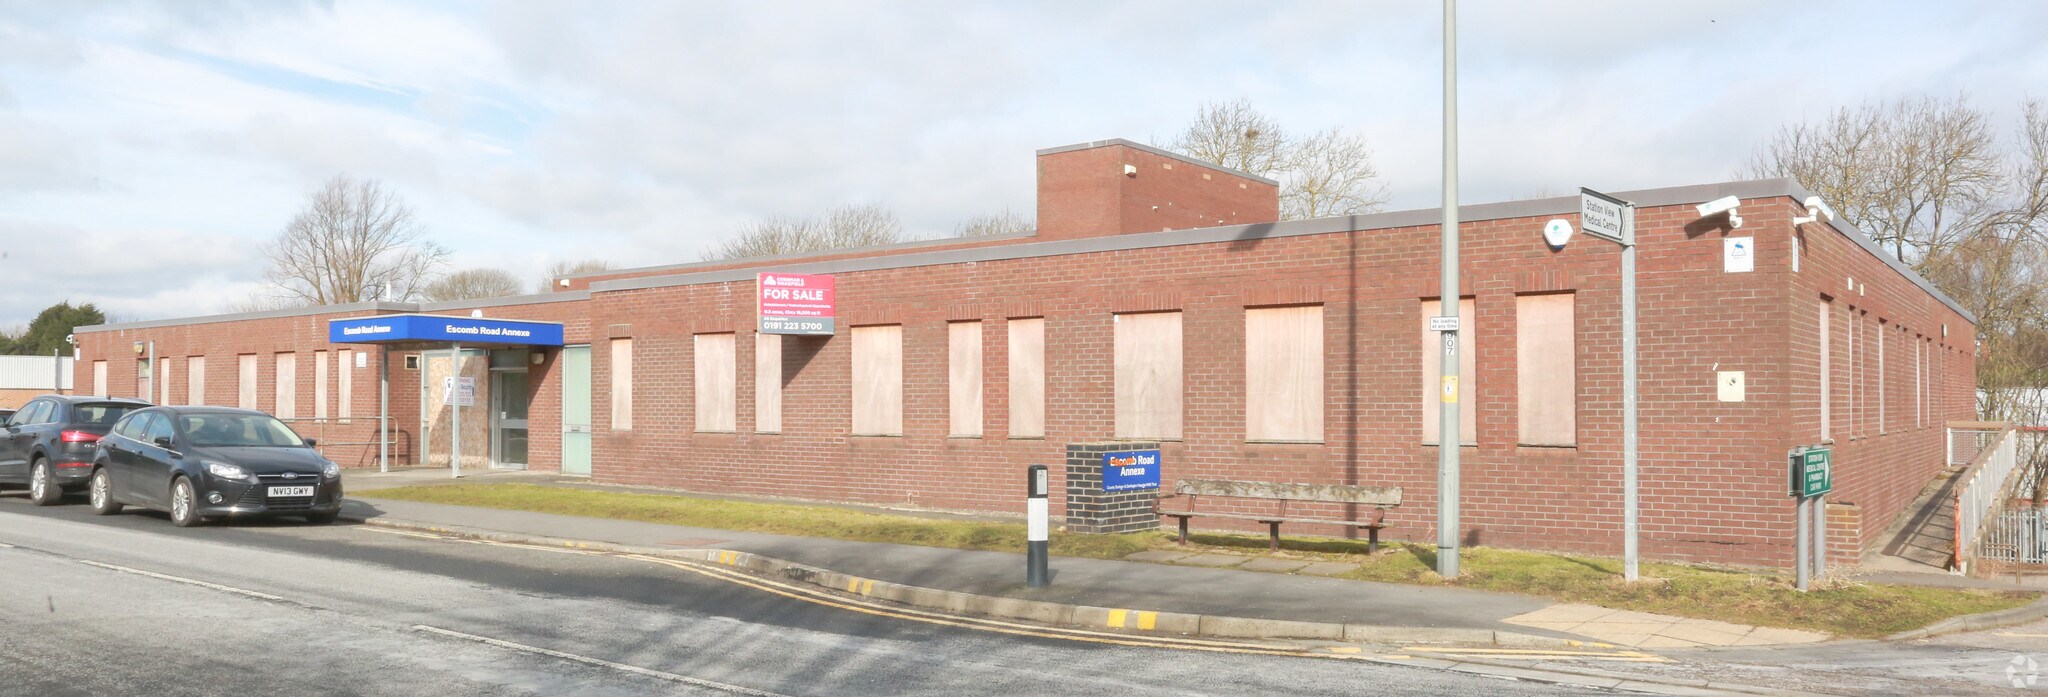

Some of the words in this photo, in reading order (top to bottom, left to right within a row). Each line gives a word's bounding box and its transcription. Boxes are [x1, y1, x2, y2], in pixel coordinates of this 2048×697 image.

[1586, 200, 1604, 214] Station
[1604, 205, 1615, 218] View
[1584, 212, 1602, 227] Medical
[1602, 218, 1618, 232] Centre
[764, 289, 789, 300] FOR
[792, 290, 823, 300] SALE
[344, 327, 361, 335] Escomb
[361, 326, 373, 334] Road
[374, 325, 391, 333] Annexe
[446, 325, 479, 334] Escomb
[480, 326, 500, 335] Road
[501, 328, 530, 337] Annexe
[1138, 454, 1155, 465] Road
[1120, 467, 1145, 476] Annexe
